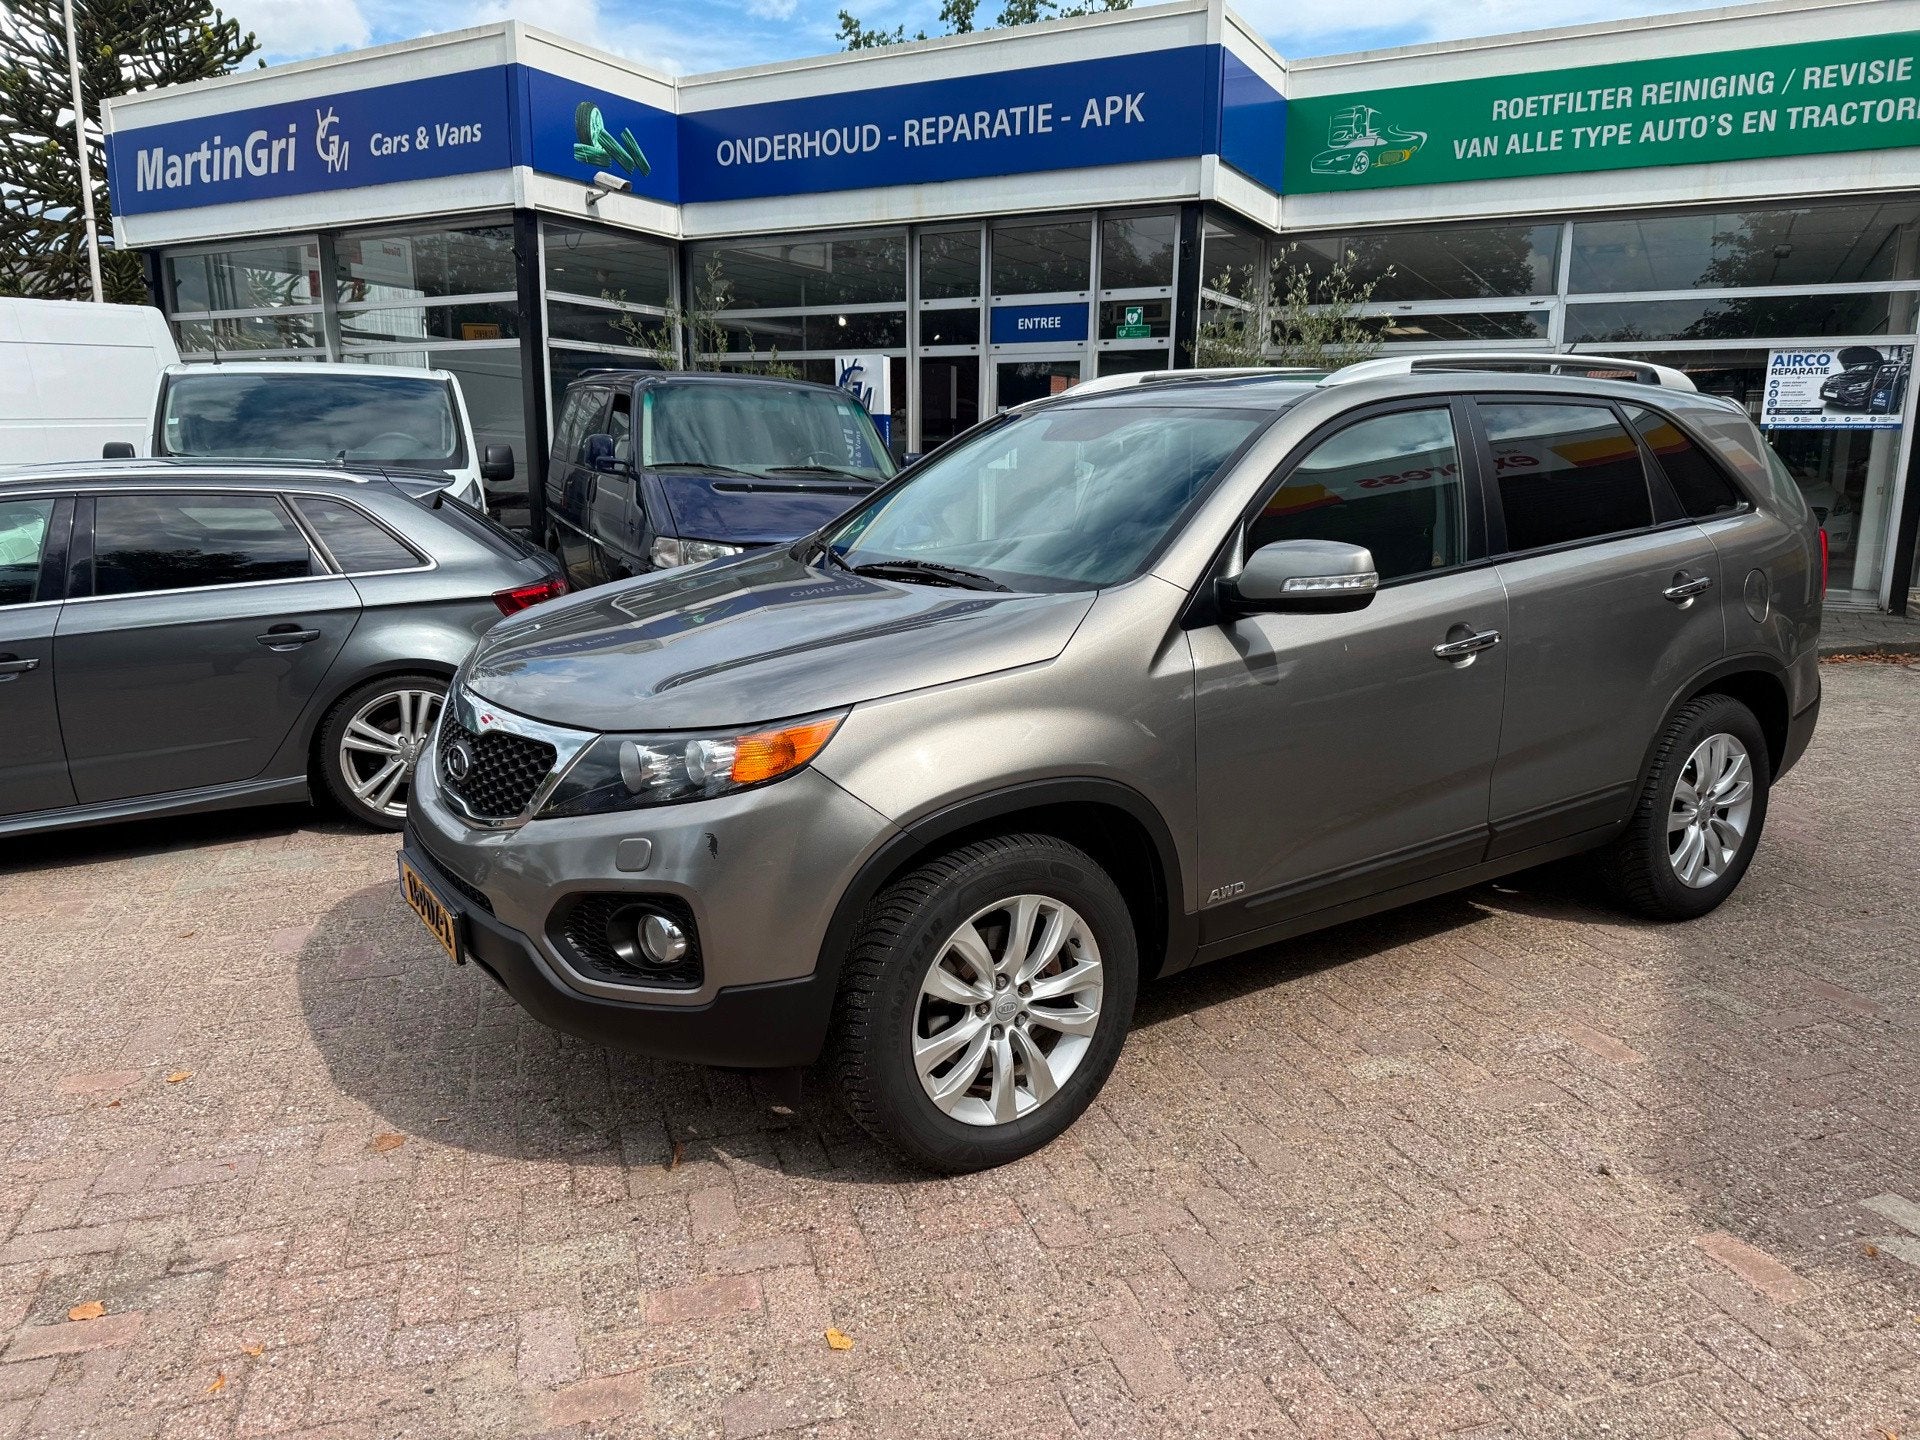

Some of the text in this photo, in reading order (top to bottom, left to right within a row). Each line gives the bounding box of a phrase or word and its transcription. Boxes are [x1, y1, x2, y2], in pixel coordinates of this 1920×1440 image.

[1492, 57, 1914, 121] ROETFILTER REINIGING / REVISIE
[716, 124, 881, 166] ONDERHOUD
[904, 103, 1053, 147] REPARATIE
[1081, 92, 1145, 128] APK
[1453, 136, 1499, 160] VAN
[1505, 130, 1564, 154] ALLE
[1571, 124, 1633, 149] TYPE
[1640, 113, 1733, 143] AUTO'S
[1742, 110, 1777, 134] EN
[135, 123, 297, 192] MartinGri
[370, 132, 410, 156] Cars
[416, 127, 430, 150] &
[435, 122, 482, 147] Vans
[1018, 316, 1061, 330] ENTREE
[1771, 367, 1830, 376] REPARATIE
[1772, 354, 1831, 367] AIRCO
[1206, 881, 1246, 904] AWD
